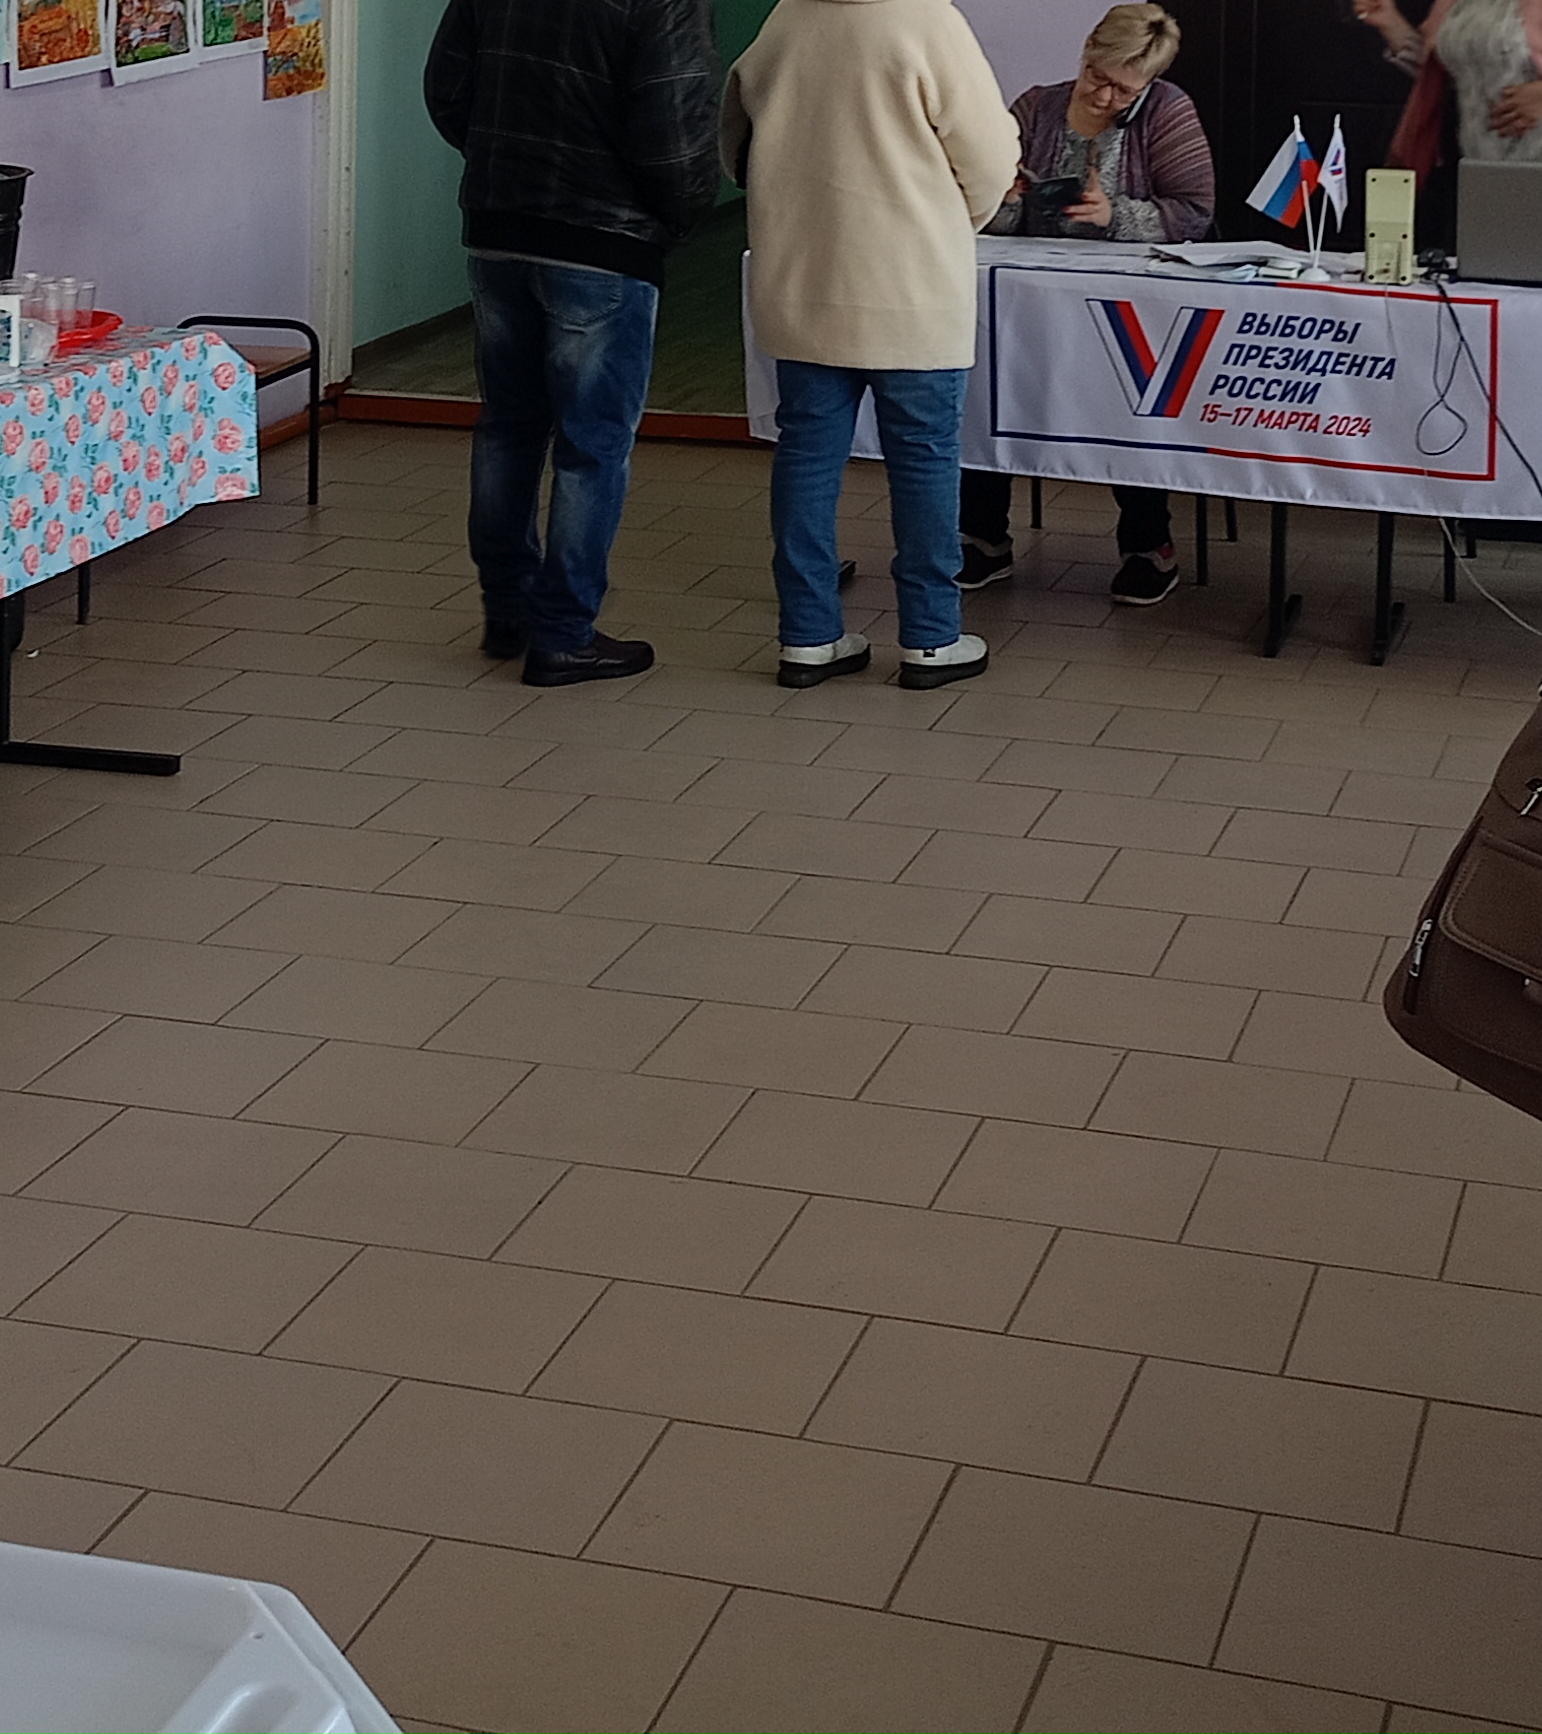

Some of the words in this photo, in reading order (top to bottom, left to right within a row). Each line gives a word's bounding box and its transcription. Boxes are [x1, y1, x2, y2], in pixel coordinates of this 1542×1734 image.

[1235, 311, 1362, 345] ВЫБОРЫ
[1221, 342, 1397, 381] ПРЕЗИДЕНТА
[1208, 373, 1322, 405] РОССИИ
[1252, 408, 1322, 434] МАРТА
[1322, 414, 1373, 438] 2024
